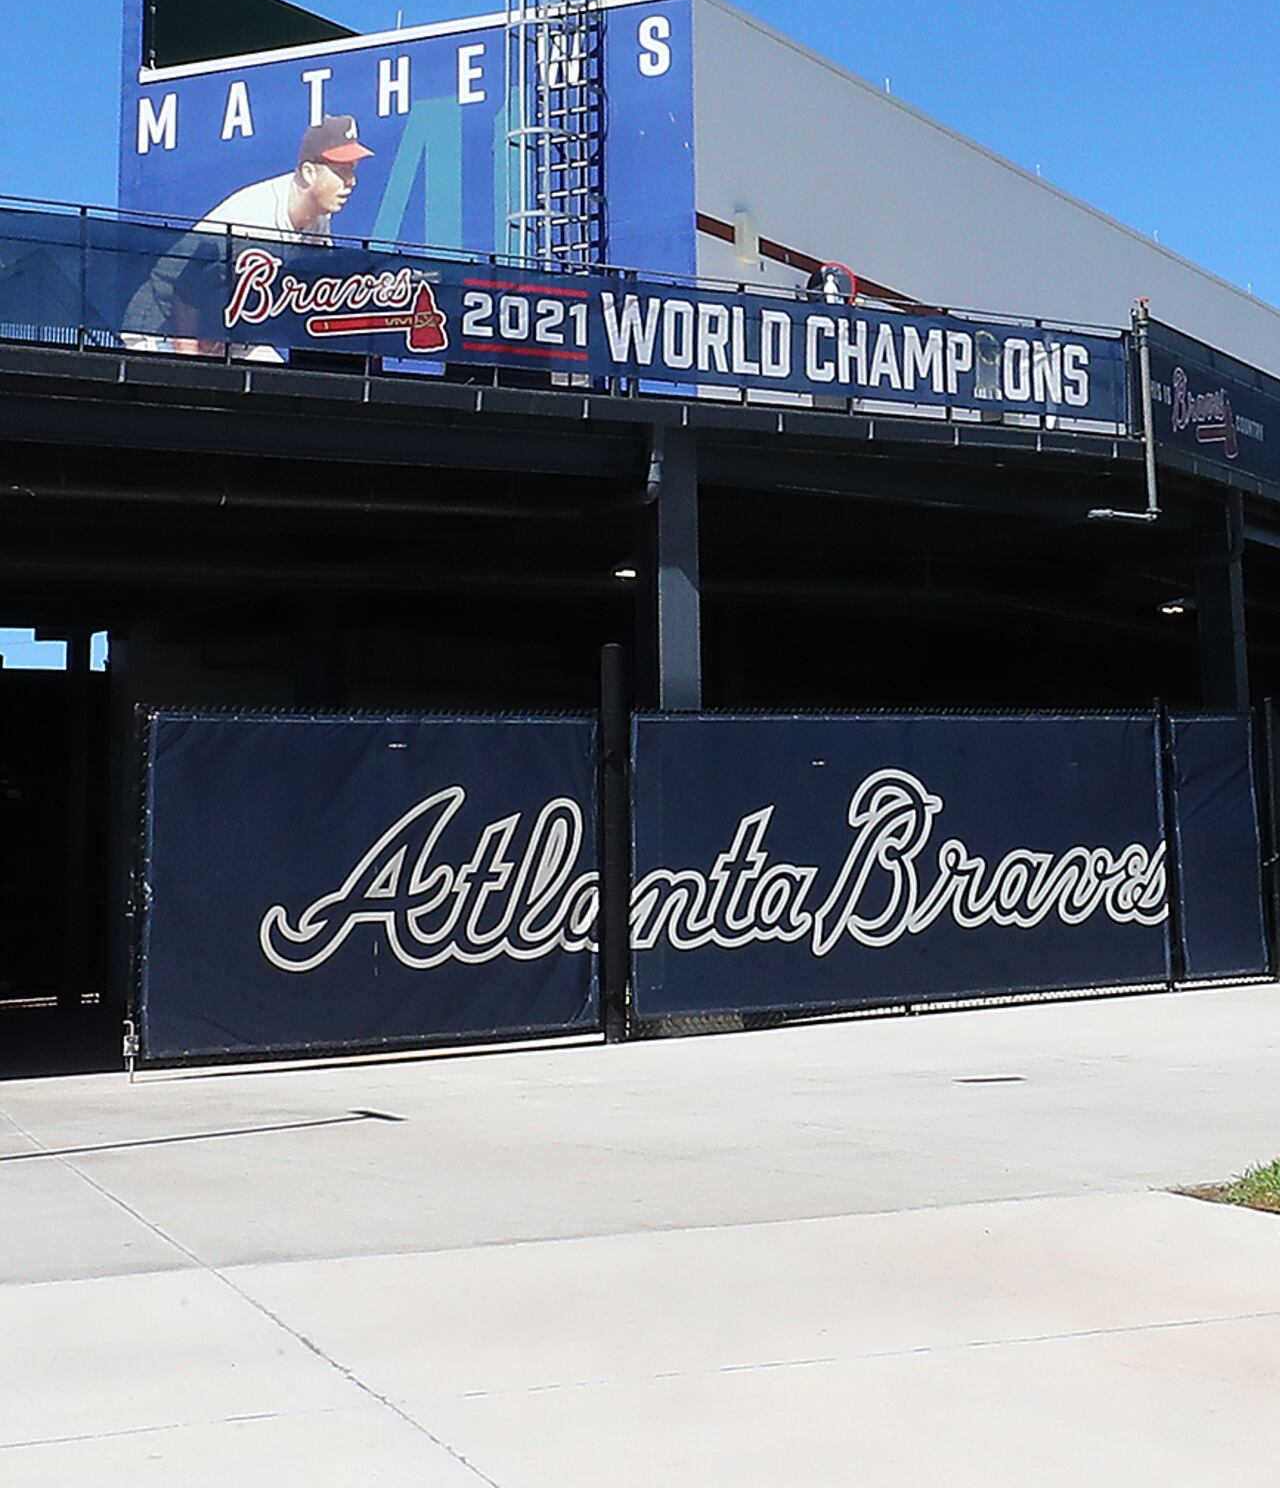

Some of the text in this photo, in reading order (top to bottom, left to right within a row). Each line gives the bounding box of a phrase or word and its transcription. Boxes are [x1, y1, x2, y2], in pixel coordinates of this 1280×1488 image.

[137, 15, 672, 154] MATHEWS
[224, 247, 412, 328] Braves
[462, 291, 588, 347] 2021
[600, 292, 792, 380] WORLD
[259, 767, 1169, 972] Atlanta Braves
